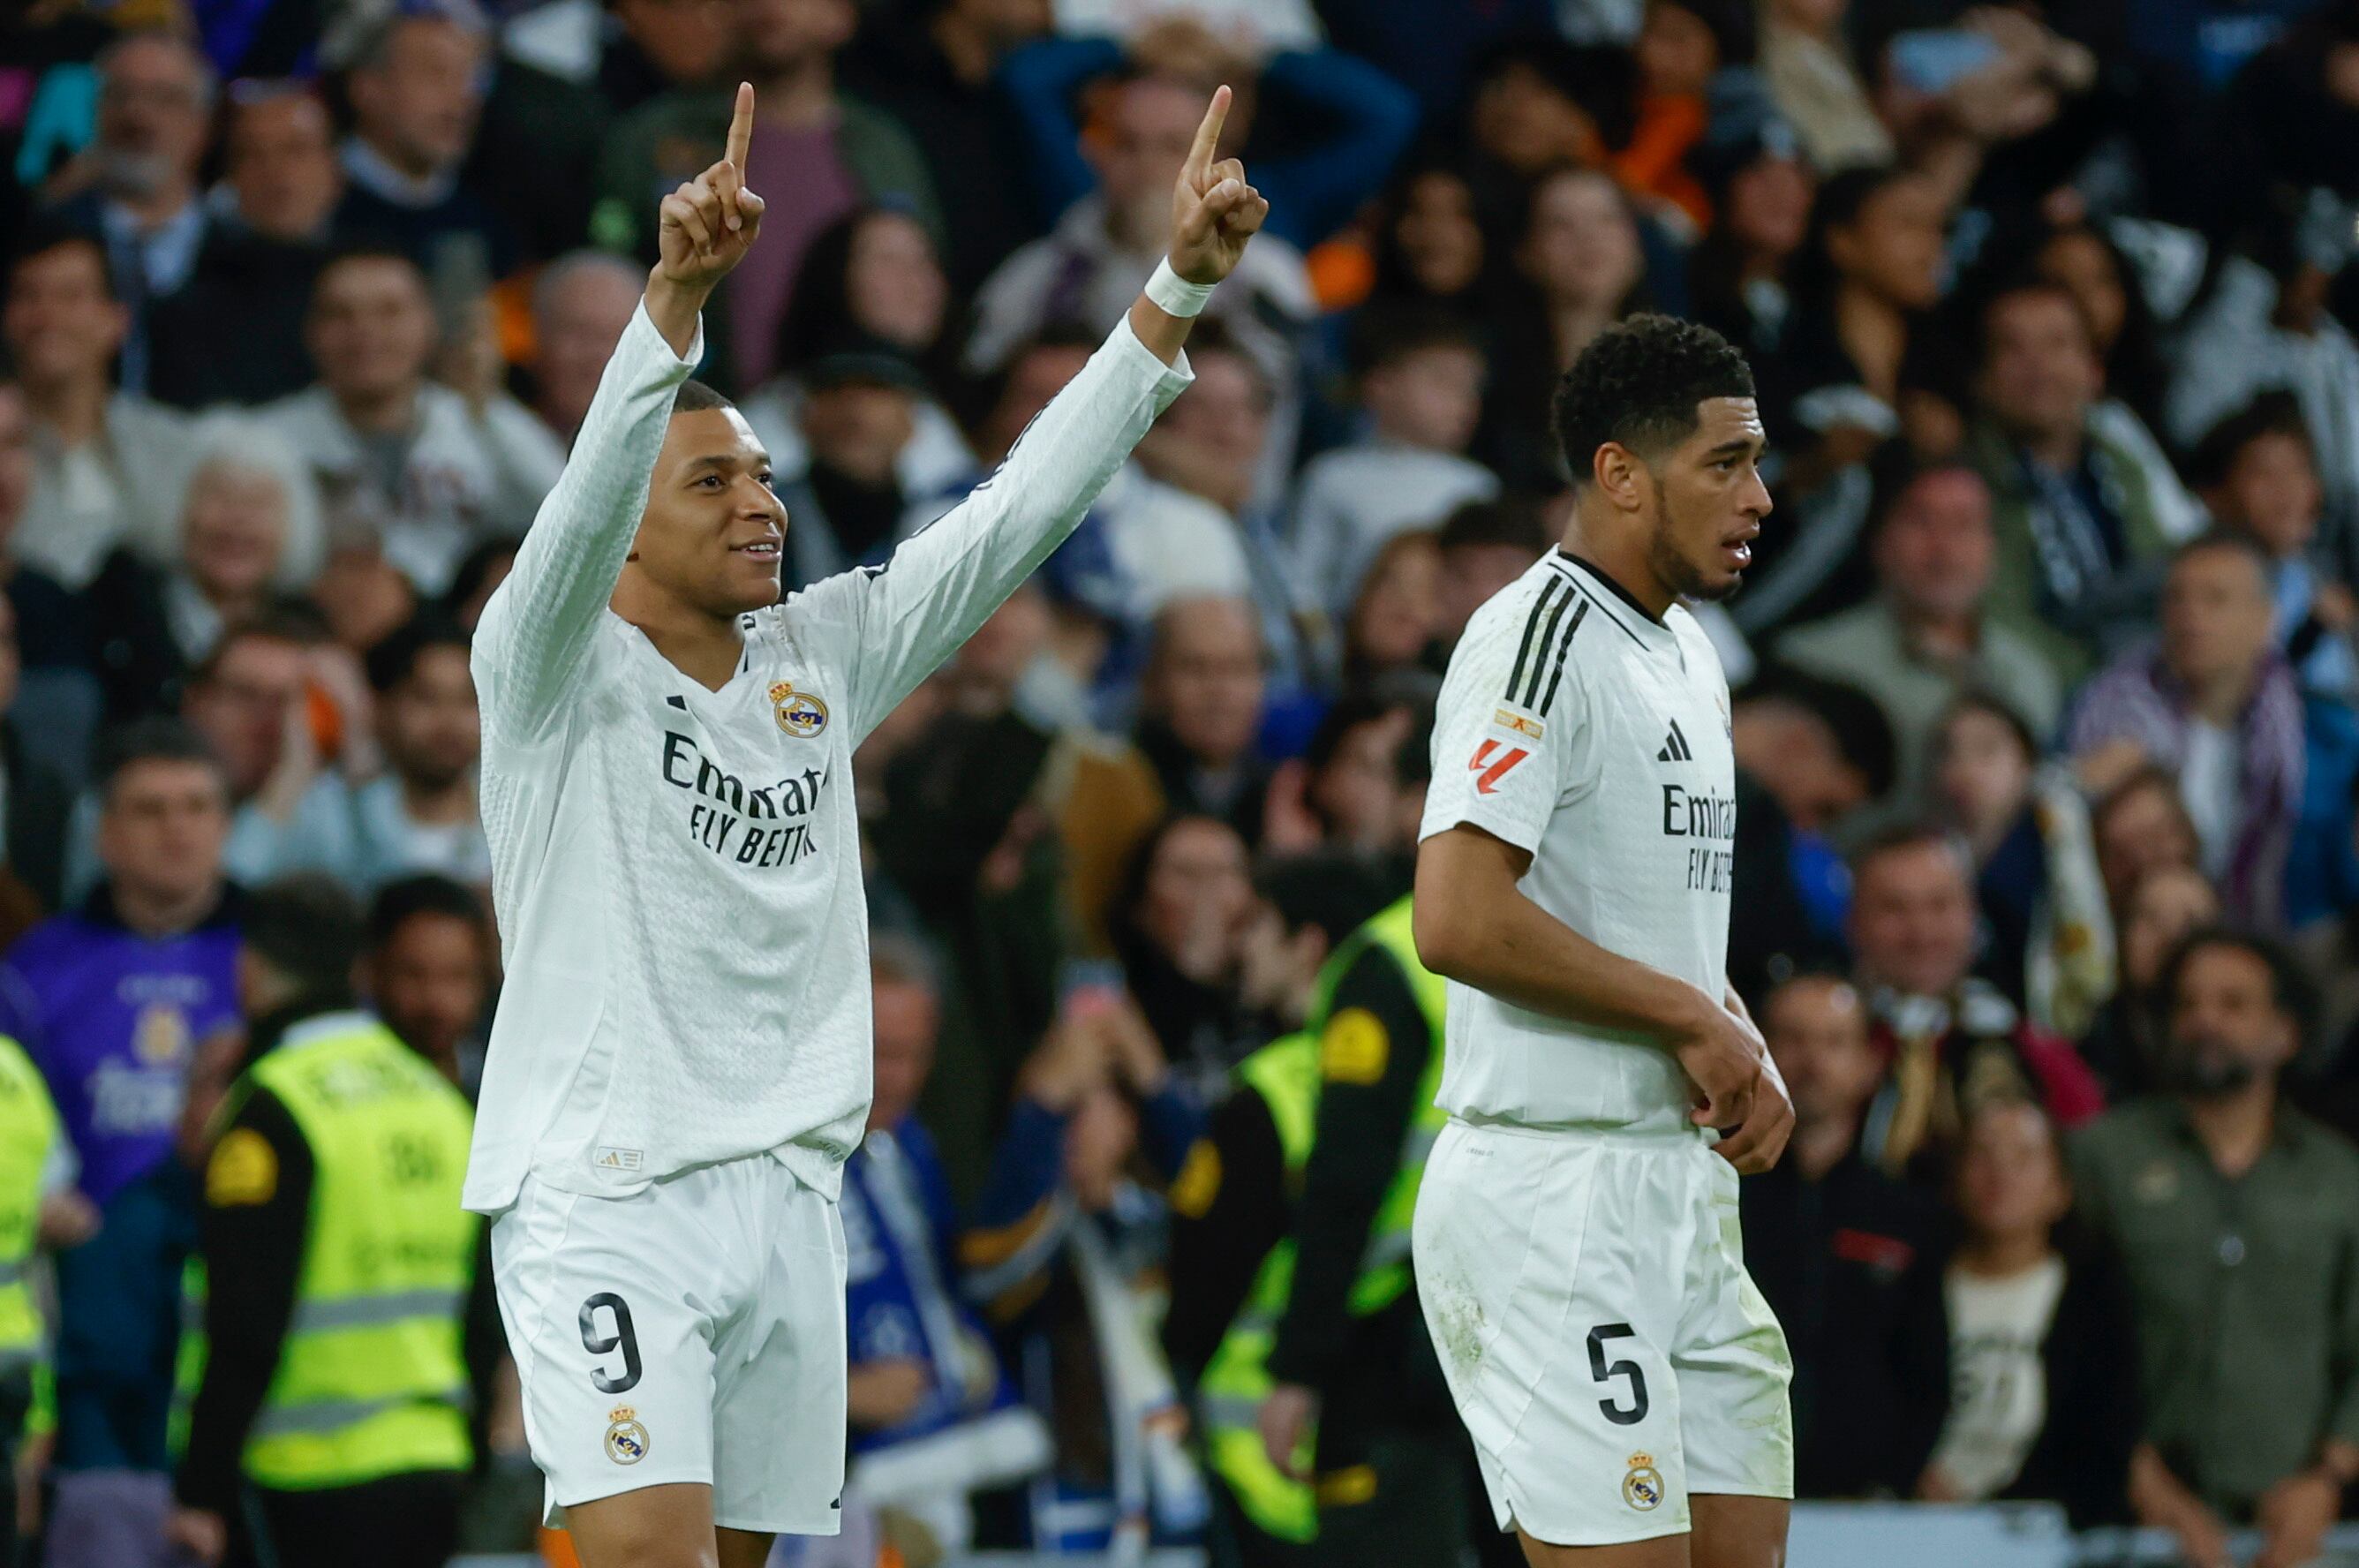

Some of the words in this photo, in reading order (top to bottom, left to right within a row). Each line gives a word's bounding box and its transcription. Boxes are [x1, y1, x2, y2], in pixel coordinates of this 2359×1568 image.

[690, 804, 737, 854] FLY
[1688, 848, 1710, 890] FLY
[578, 1293, 643, 1394] 9
[1586, 1323, 1649, 1425] 5
